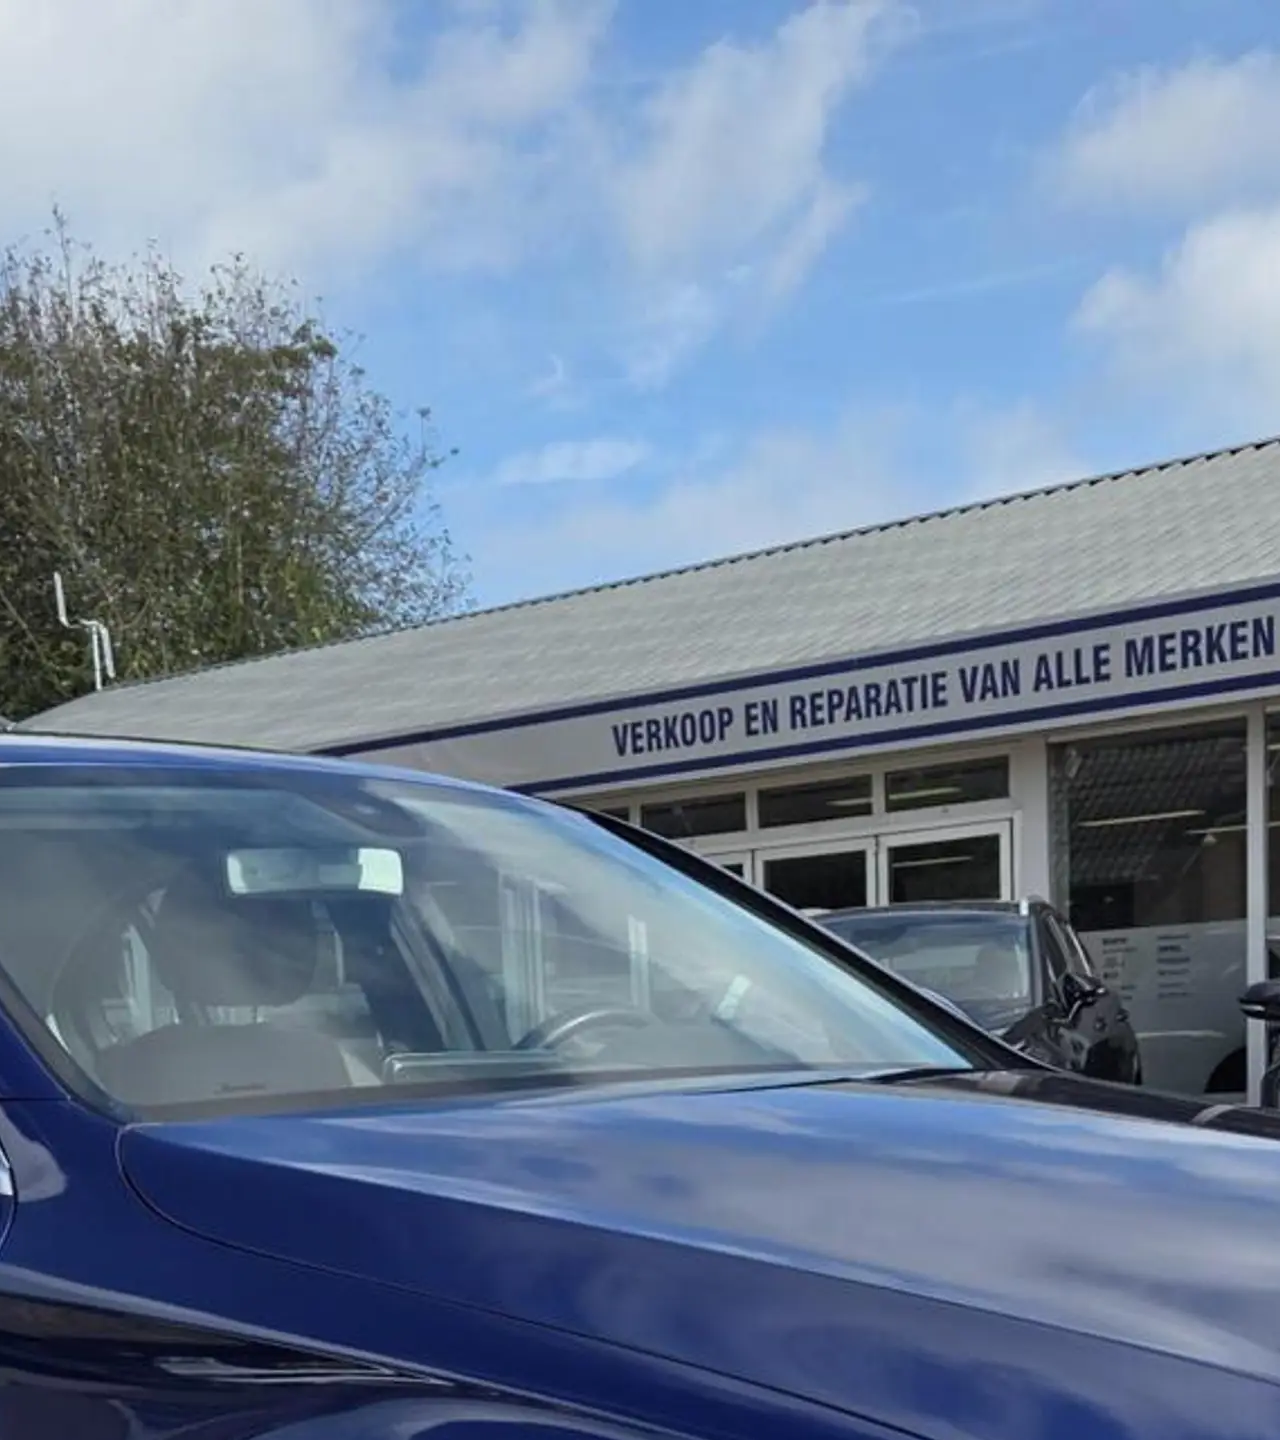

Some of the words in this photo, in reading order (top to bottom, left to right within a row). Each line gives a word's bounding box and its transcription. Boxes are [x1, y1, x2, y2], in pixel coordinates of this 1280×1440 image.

[612, 706, 734, 757] VERKOOP
[745, 700, 779, 738] EN
[789, 671, 949, 729] REPARATIE
[958, 659, 1021, 703] VAN
[1032, 644, 1112, 694] ALLE
[1123, 615, 1276, 677] MERKEN
